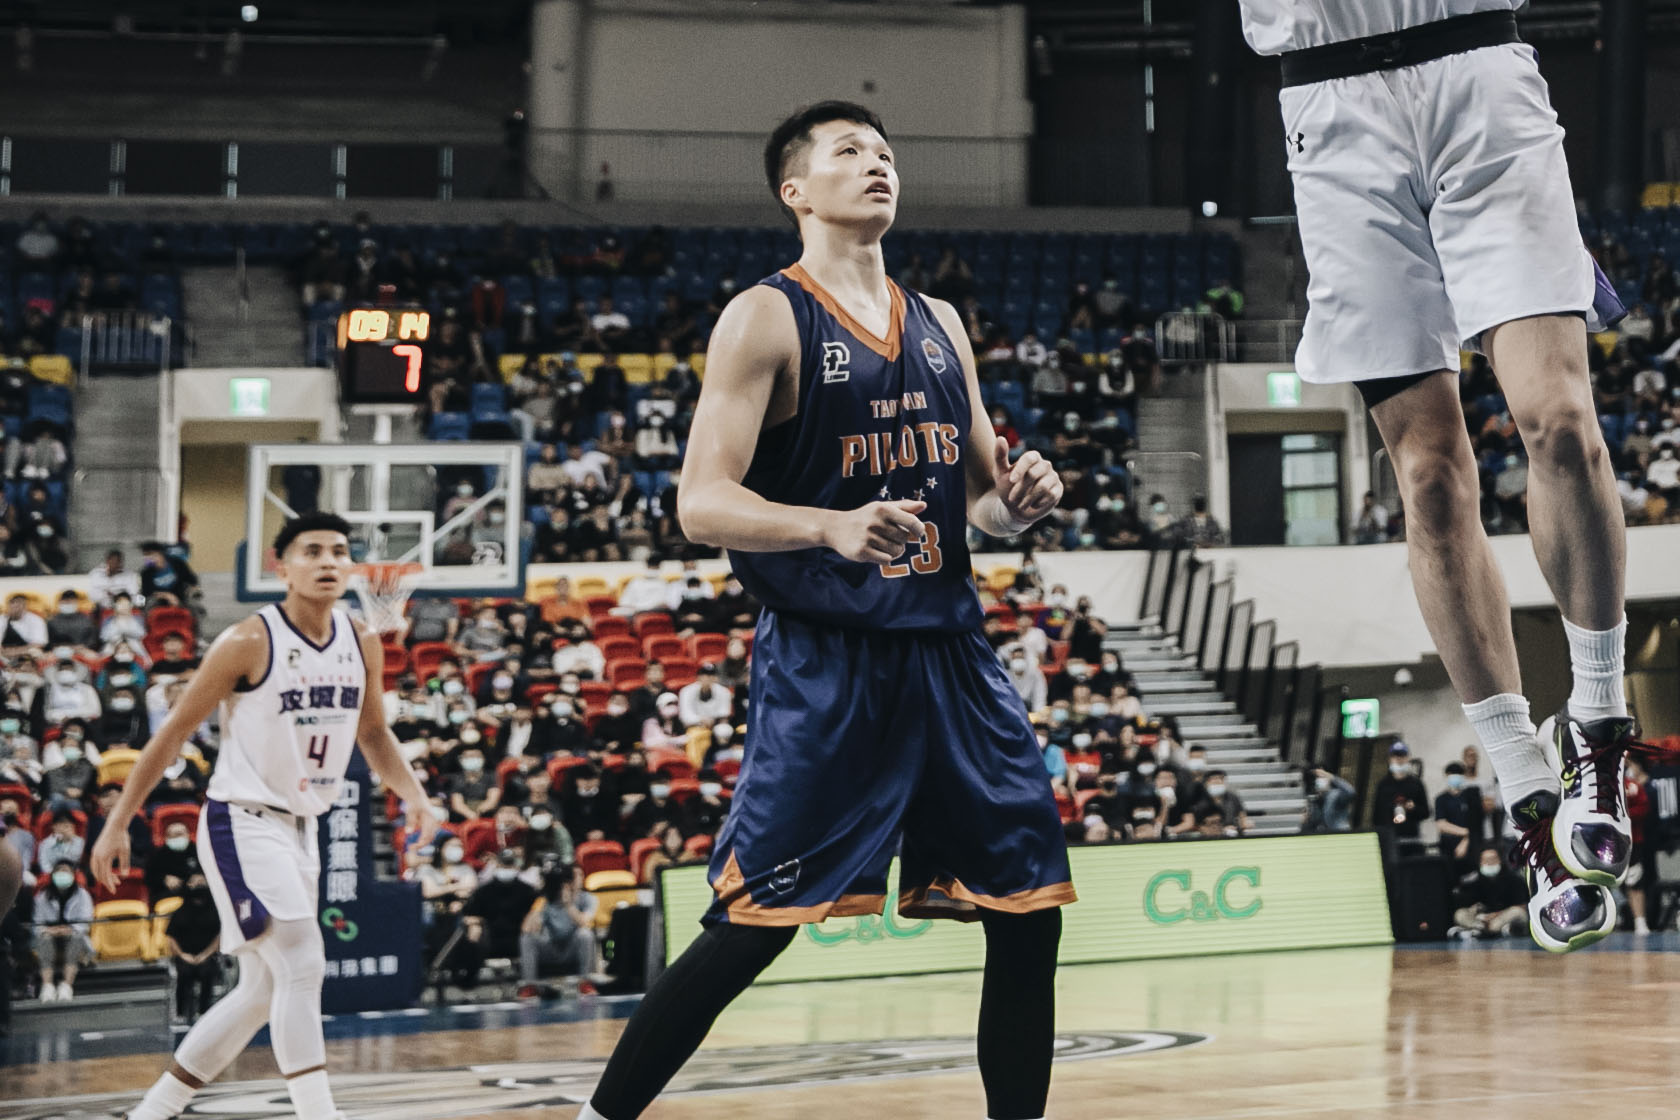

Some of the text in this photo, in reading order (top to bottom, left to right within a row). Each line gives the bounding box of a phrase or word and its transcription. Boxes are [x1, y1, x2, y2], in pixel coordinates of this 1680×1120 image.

[392, 344, 423, 393] 7
[869, 391, 928, 419] TAOAN
[840, 421, 960, 478] PILOTS
[307, 734, 330, 770] 4
[1143, 865, 1263, 927] C&C
